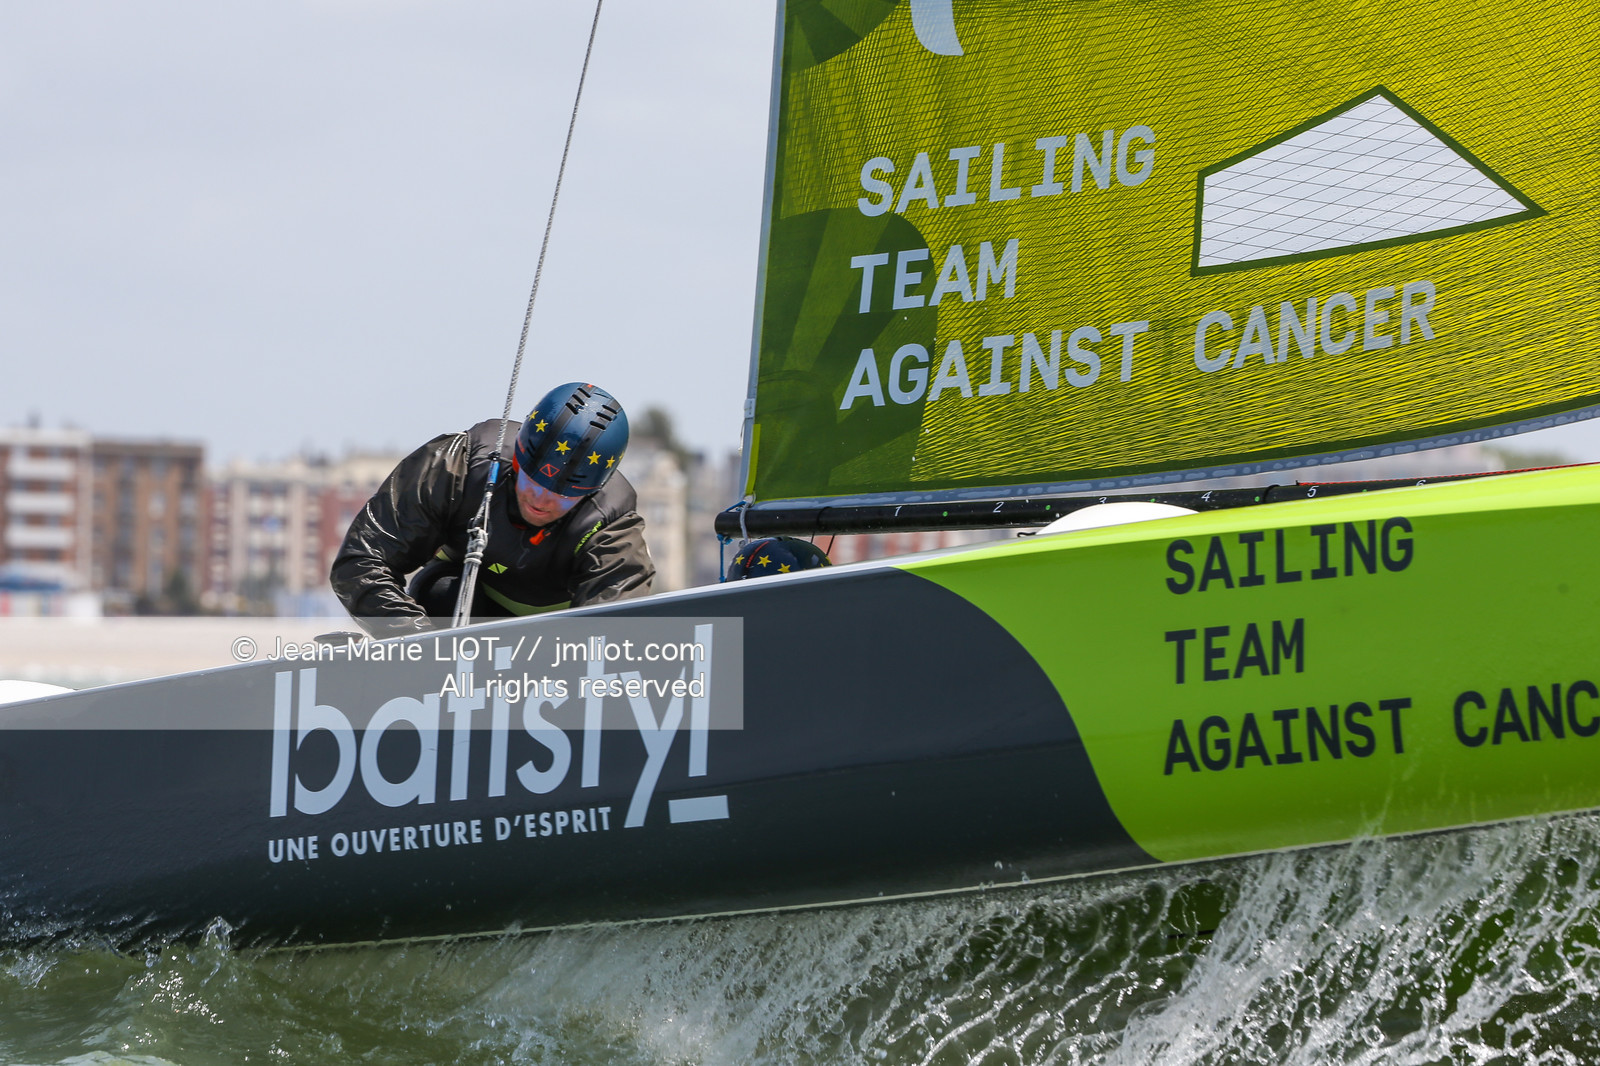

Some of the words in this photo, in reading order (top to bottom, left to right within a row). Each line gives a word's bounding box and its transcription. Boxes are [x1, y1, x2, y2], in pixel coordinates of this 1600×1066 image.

[857, 124, 1157, 217] SAILING
[849, 237, 1020, 314] TEAM
[839, 320, 1149, 411] AGAINST
[1193, 279, 1437, 374] CANCER
[894, 505, 903, 517] 1
[992, 501, 1005, 513] 2
[1200, 490, 1213, 502] 4
[1307, 485, 1320, 498] 5
[1165, 516, 1415, 595] SAILING
[1164, 617, 1305, 685] TEAM
[1163, 697, 1412, 775] AGAINST
[1453, 679, 1600, 748] CANC
[267, 834, 320, 864] UNE
[329, 818, 483, 857] OUVERTURE
[494, 805, 612, 842] D'ESPRIT
